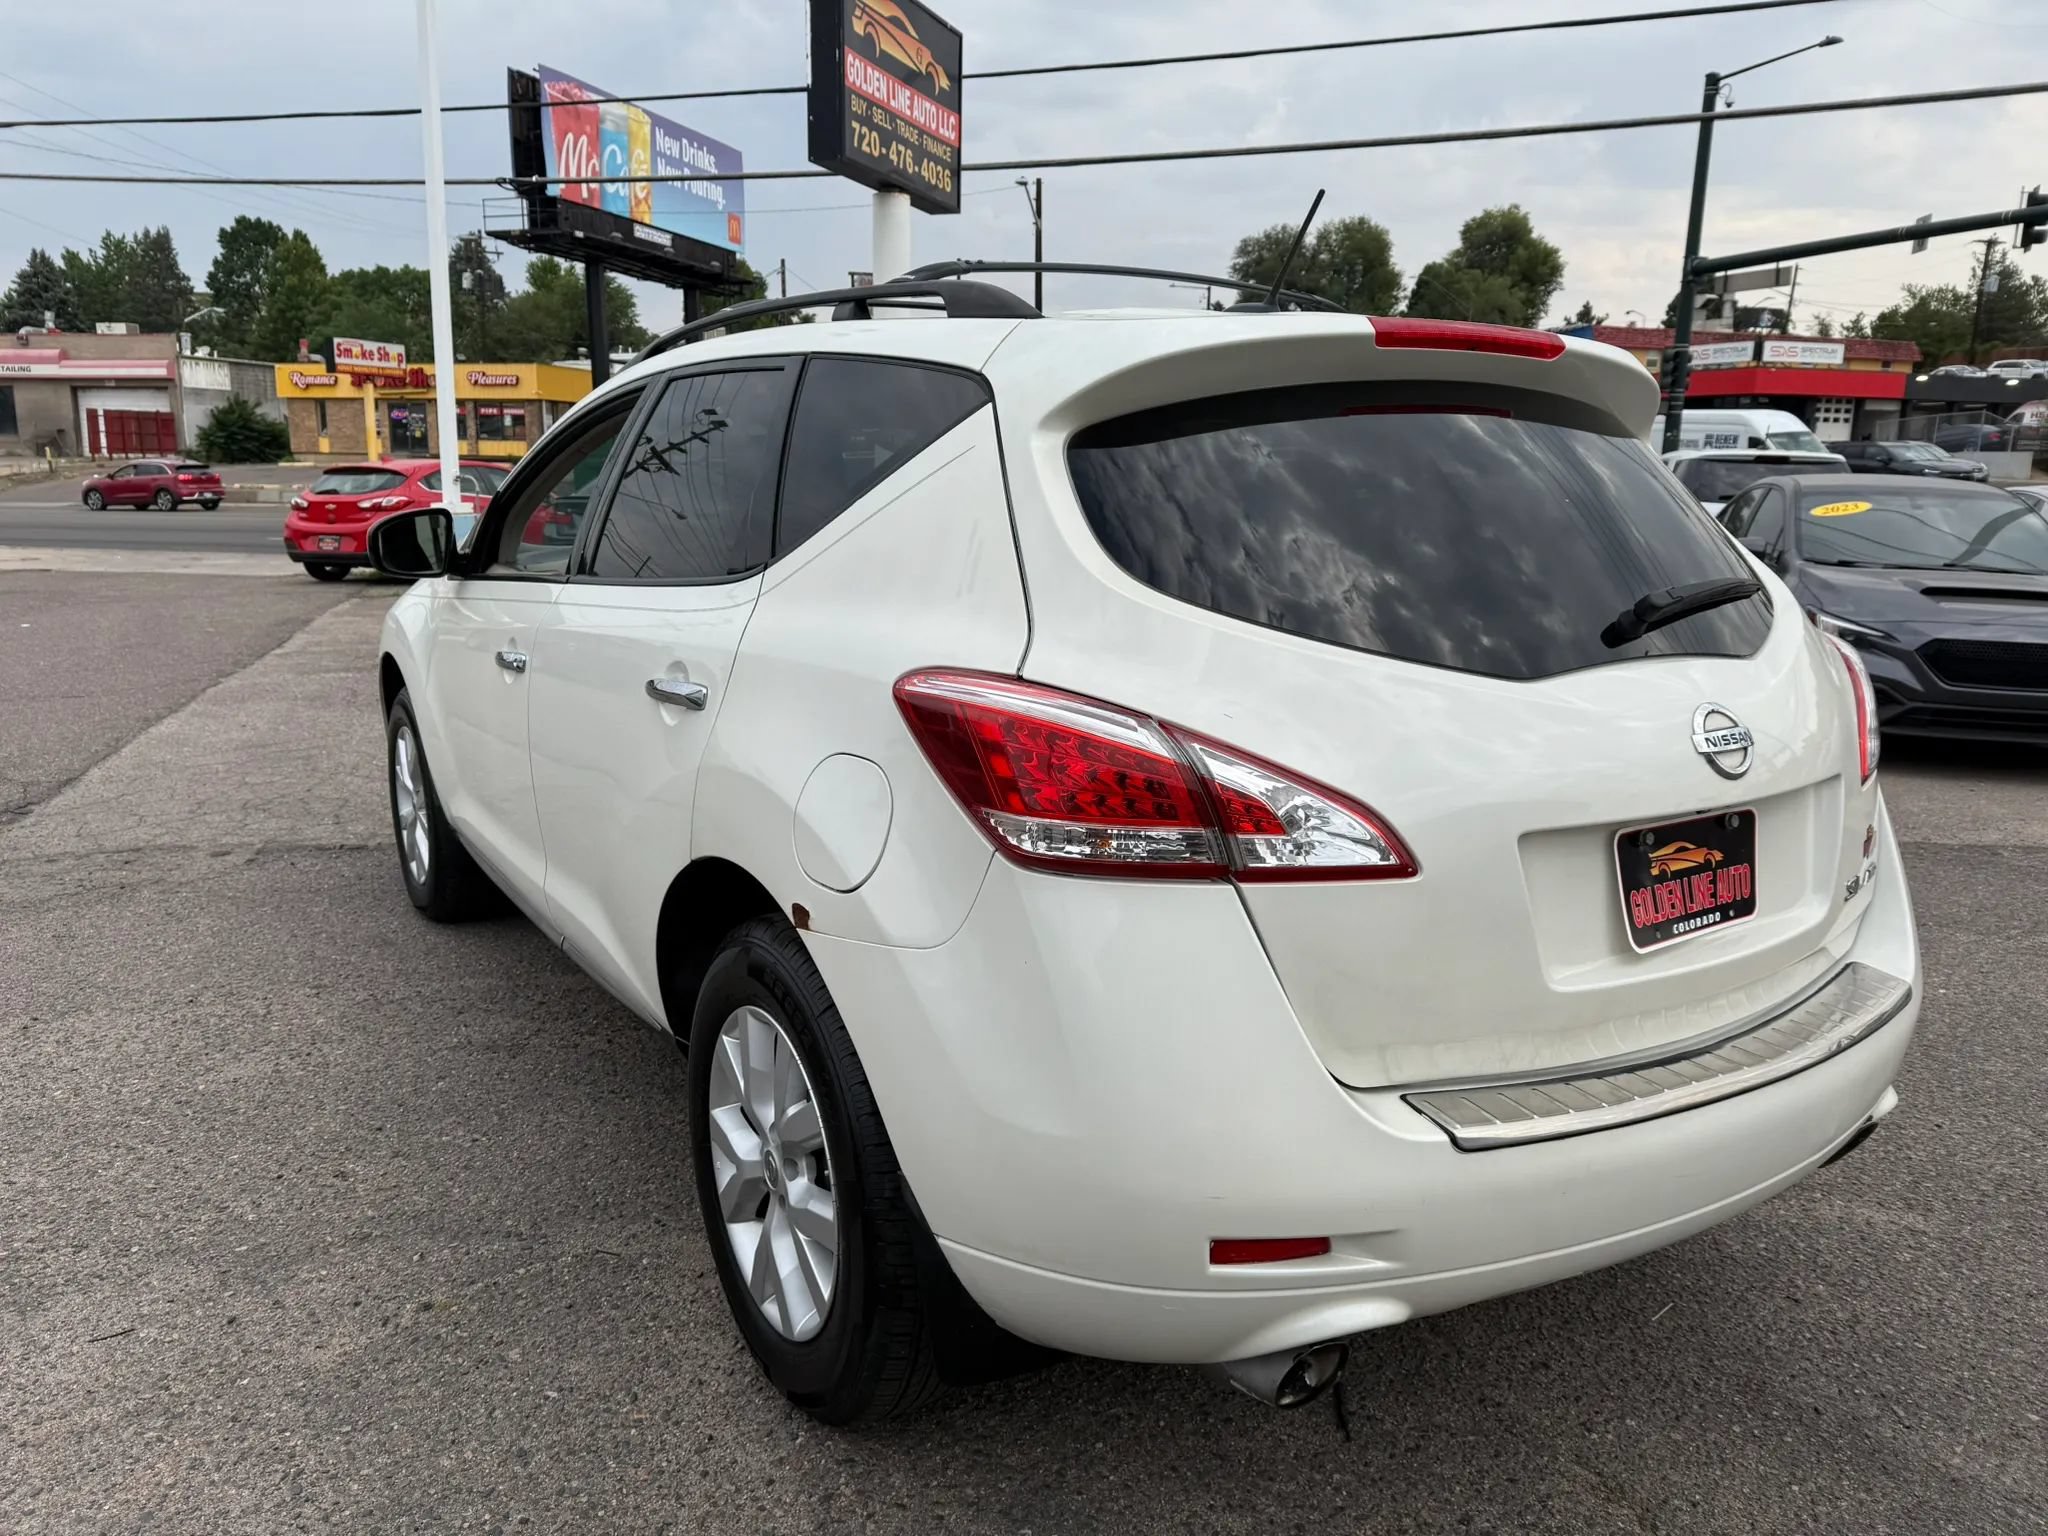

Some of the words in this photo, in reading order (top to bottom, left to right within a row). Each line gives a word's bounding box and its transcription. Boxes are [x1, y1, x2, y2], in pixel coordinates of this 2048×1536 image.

[847, 54, 887, 102] GOLDEN
[890, 80, 911, 116] LINE
[913, 99, 936, 132] AUTO
[939, 112, 956, 140] LLC
[851, 95, 867, 116] BUY
[872, 106, 892, 130] SELL
[896, 119, 919, 145] TRADE
[923, 135, 952, 162] FINANCE
[656, 126, 680, 158] New
[290, 372, 336, 388] Romance
[467, 371, 517, 385] Pleasures
[1822, 503, 1859, 515] 2023
[1704, 731, 1753, 749] NISSAN
[1630, 879, 1685, 928] GOLDEN
[1683, 871, 1715, 914] LINE
[1717, 863, 1751, 905] AUTO
[1672, 912, 1721, 934] COLORADO
